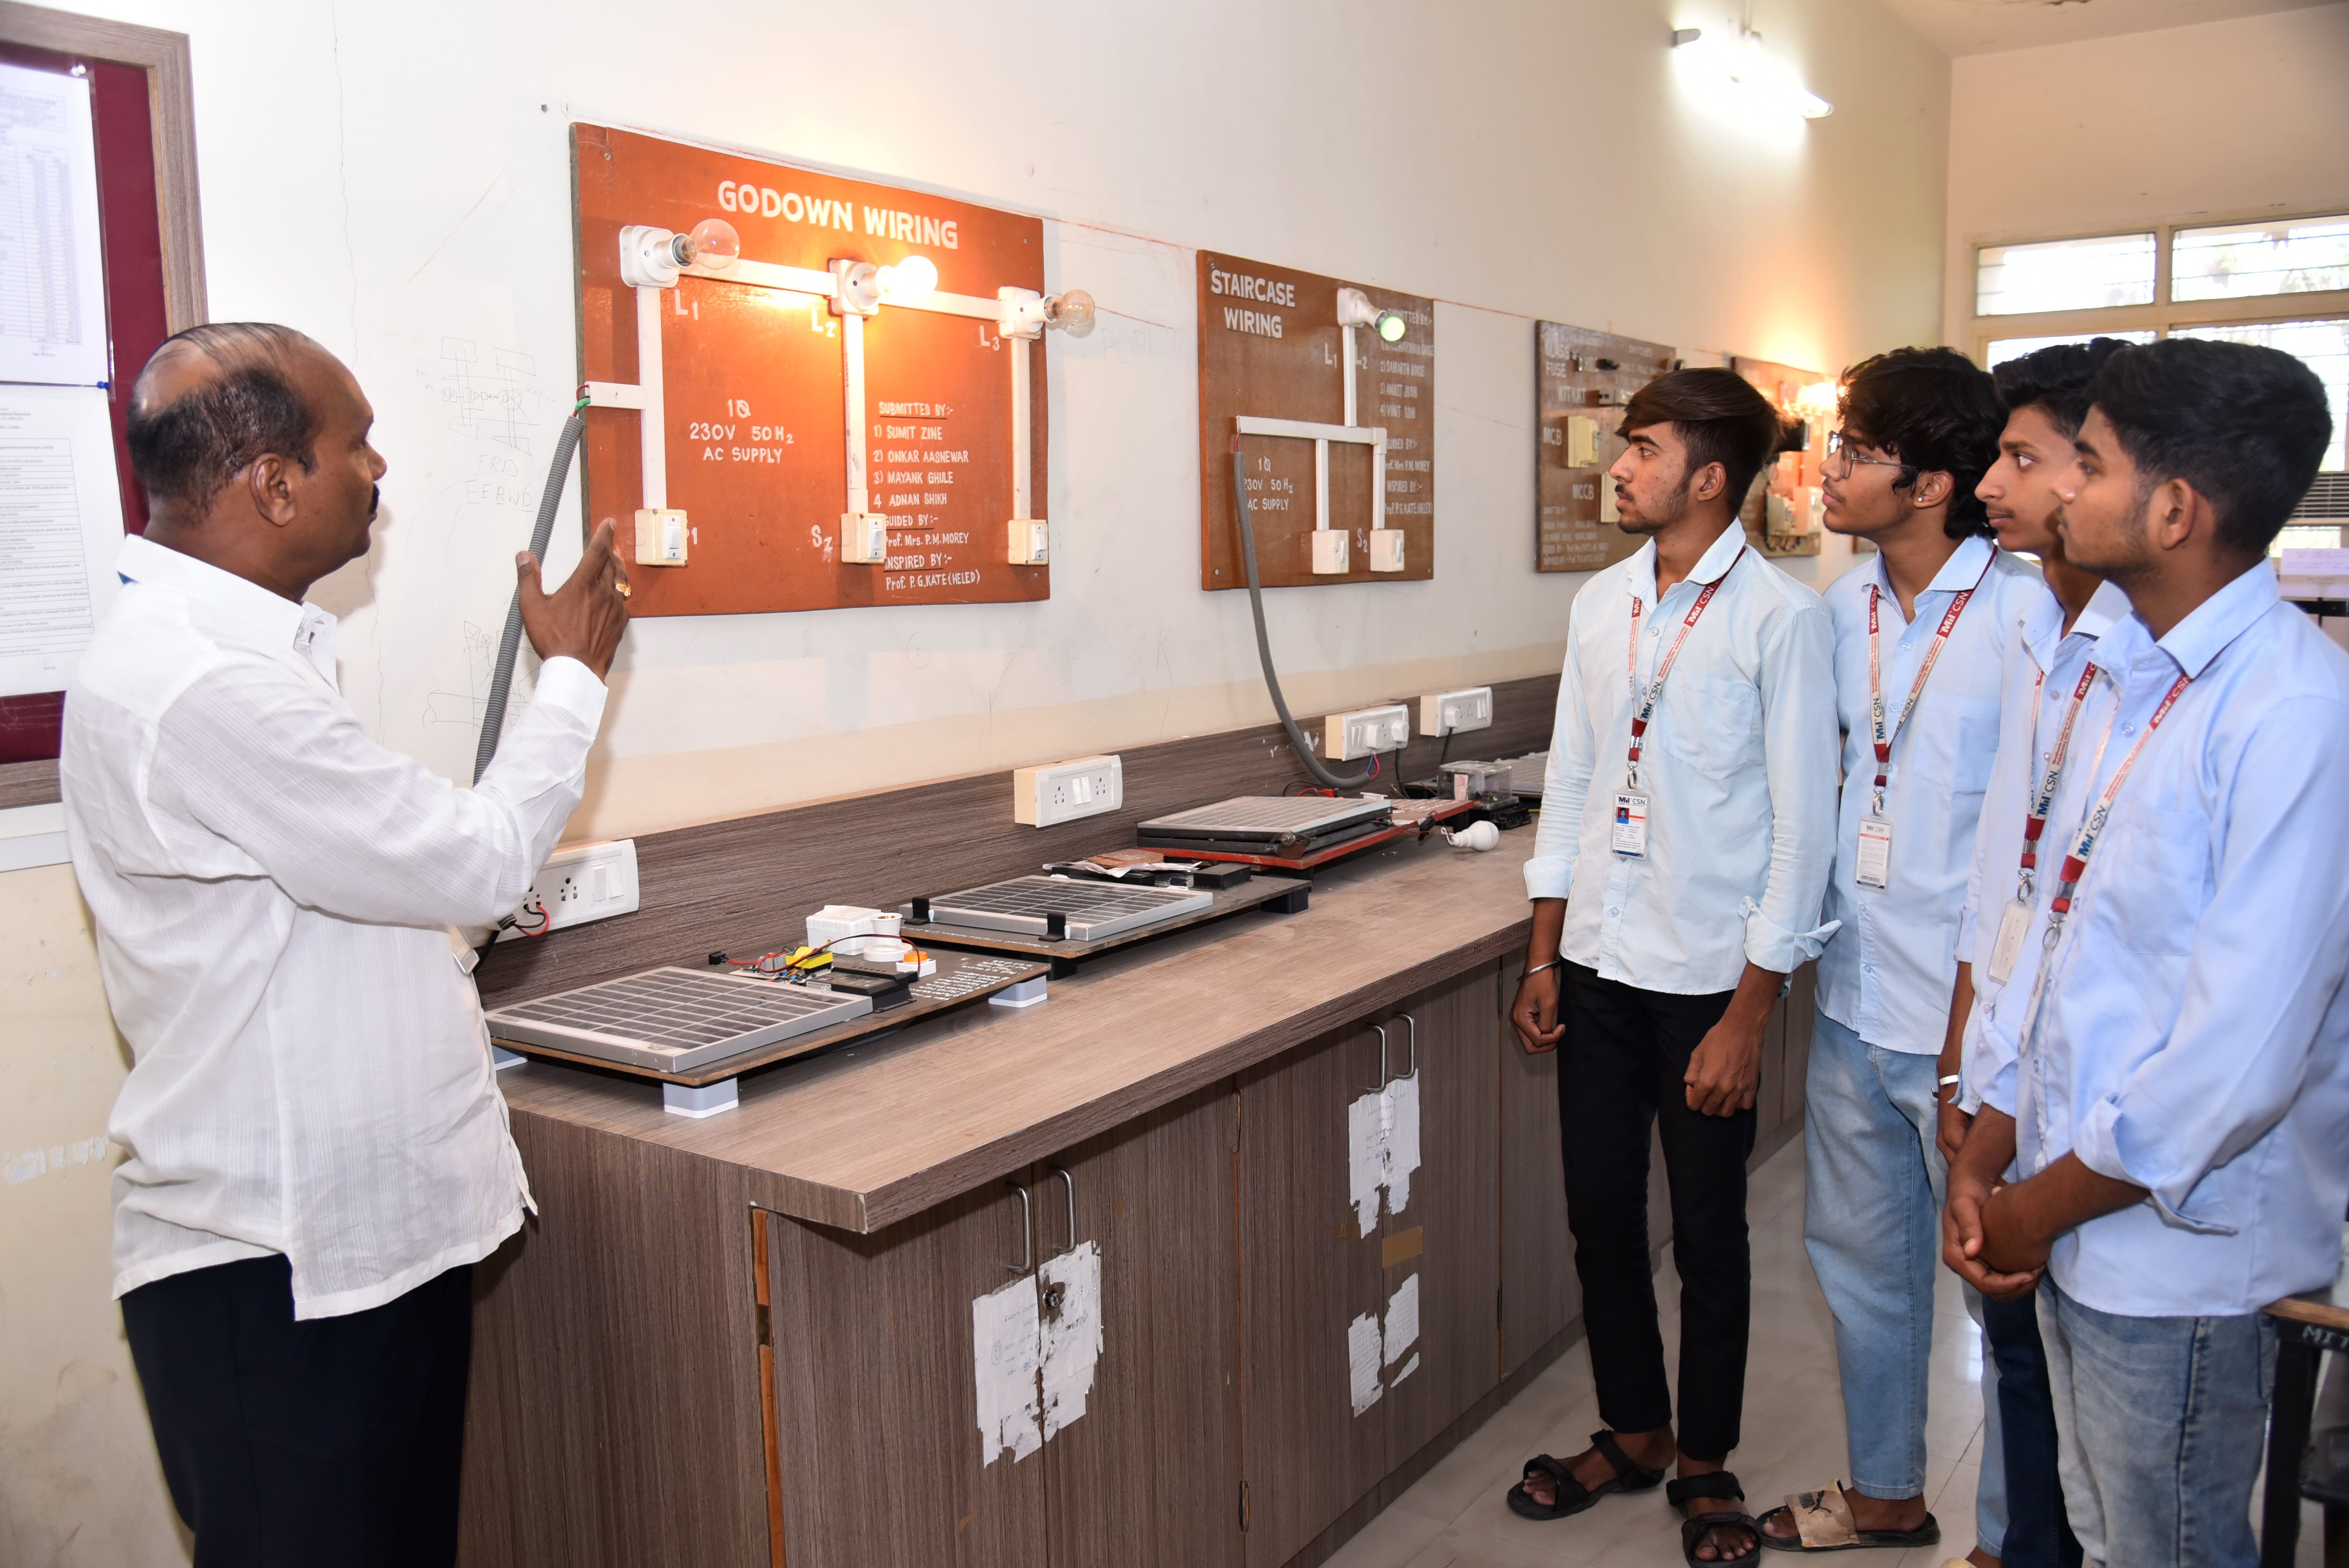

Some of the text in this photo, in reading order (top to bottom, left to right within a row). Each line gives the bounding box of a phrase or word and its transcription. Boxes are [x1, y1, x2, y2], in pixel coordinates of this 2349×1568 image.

[718, 180, 958, 249] GODOWN WIRING
[1211, 269, 1296, 308] STAIRCASE
[1224, 306, 1283, 339] WIRING
[1546, 361, 1567, 378] FUSE
[879, 401, 931, 416] SUBMITTED
[690, 422, 736, 441] 230V
[886, 424, 916, 440] SUMIT
[920, 426, 943, 440] ZINE
[1543, 426, 1562, 446] MCB
[703, 446, 783, 463] AC SUPPLY
[873, 449, 883, 463] 2)
[888, 449, 920, 463] ONKAR
[873, 470, 954, 484] 3) MAYANK GHULE
[889, 493, 920, 507] ADNAN
[924, 492, 948, 505] SHIKH
[1572, 483, 1595, 500] MCCB
[1248, 497, 1289, 511] AC SUPPLY
[905, 534, 923, 546] Mrs.
[885, 554, 925, 570] INSPIRED
[886, 576, 906, 590] Prof.
[1700, 586, 1715, 605] CSN
[1953, 592, 1969, 611] CSN
[1649, 681, 1662, 700] CSN
[1873, 698, 1881, 717] CSN
[2044, 770, 2059, 793] CSN
[2090, 804, 2107, 831] CSN
